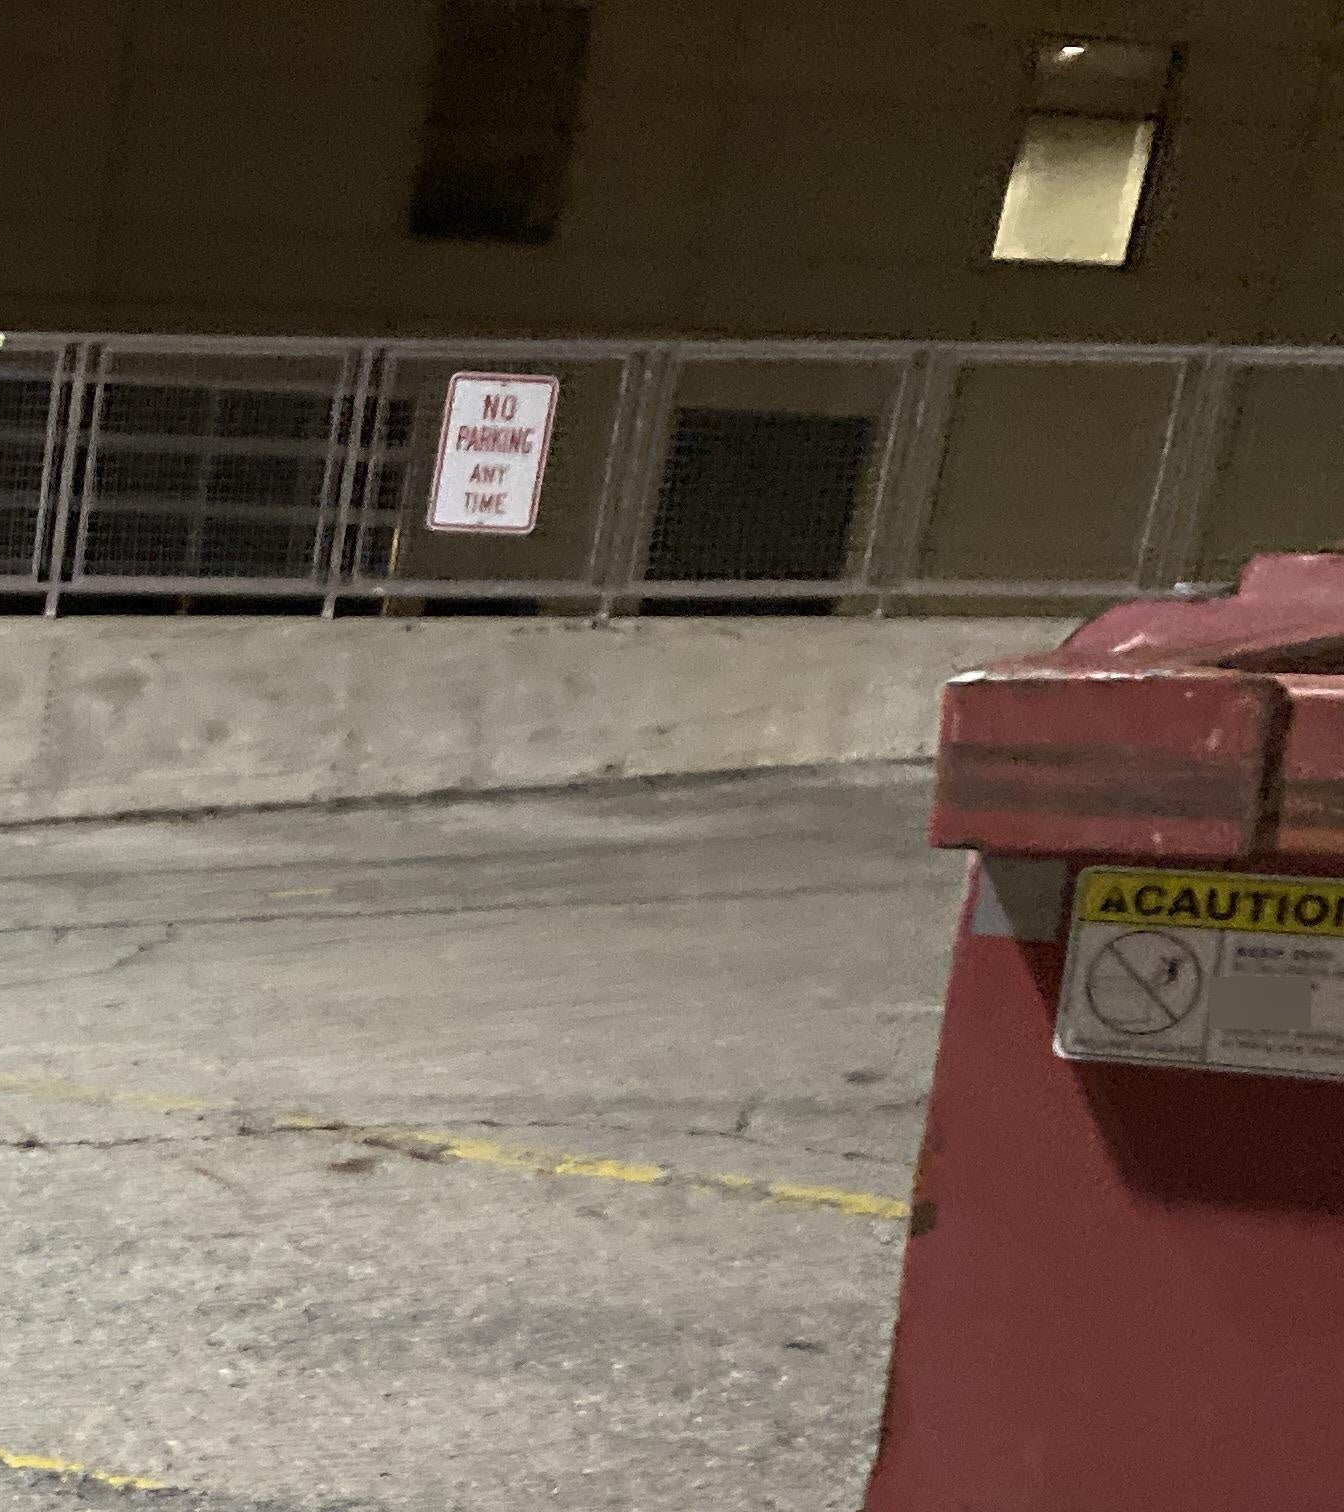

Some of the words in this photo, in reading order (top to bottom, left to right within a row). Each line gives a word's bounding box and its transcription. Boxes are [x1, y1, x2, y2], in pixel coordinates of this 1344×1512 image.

[483, 394, 518, 421] NO
[455, 425, 534, 454] PARKING
[470, 464, 510, 485] ANY
[464, 492, 508, 514] TIME
